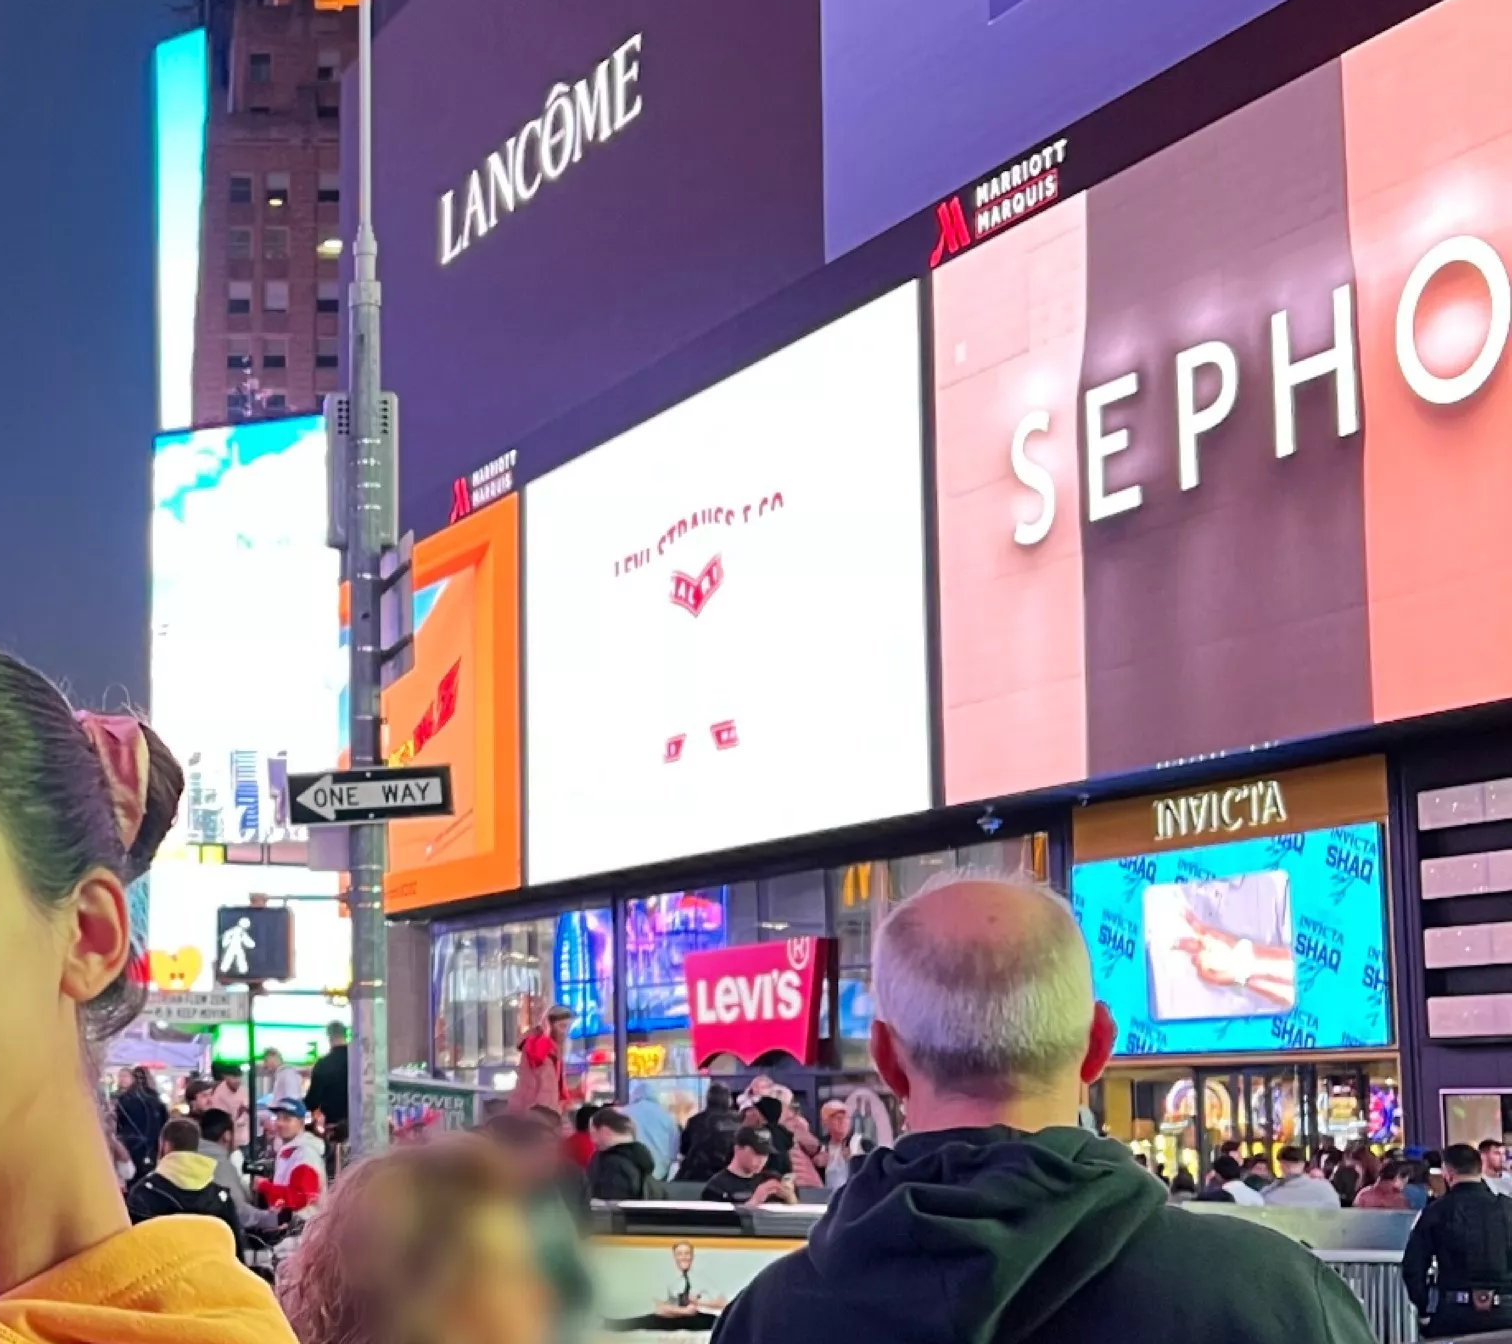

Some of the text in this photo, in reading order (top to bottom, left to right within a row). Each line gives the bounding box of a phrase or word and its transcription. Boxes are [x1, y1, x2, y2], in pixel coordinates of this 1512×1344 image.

[441, 32, 643, 265] LANCÔME
[975, 139, 1067, 206] MARRIOTT
[976, 175, 1056, 233] MARQUIS
[1009, 234, 1512, 546] SEPHO
[314, 782, 430, 808] ONE WAY
[1153, 780, 1287, 841] INVICTA
[1326, 844, 1375, 885] SHAQ
[1098, 924, 1135, 961] SHAQ
[1295, 933, 1342, 974] SHAQ
